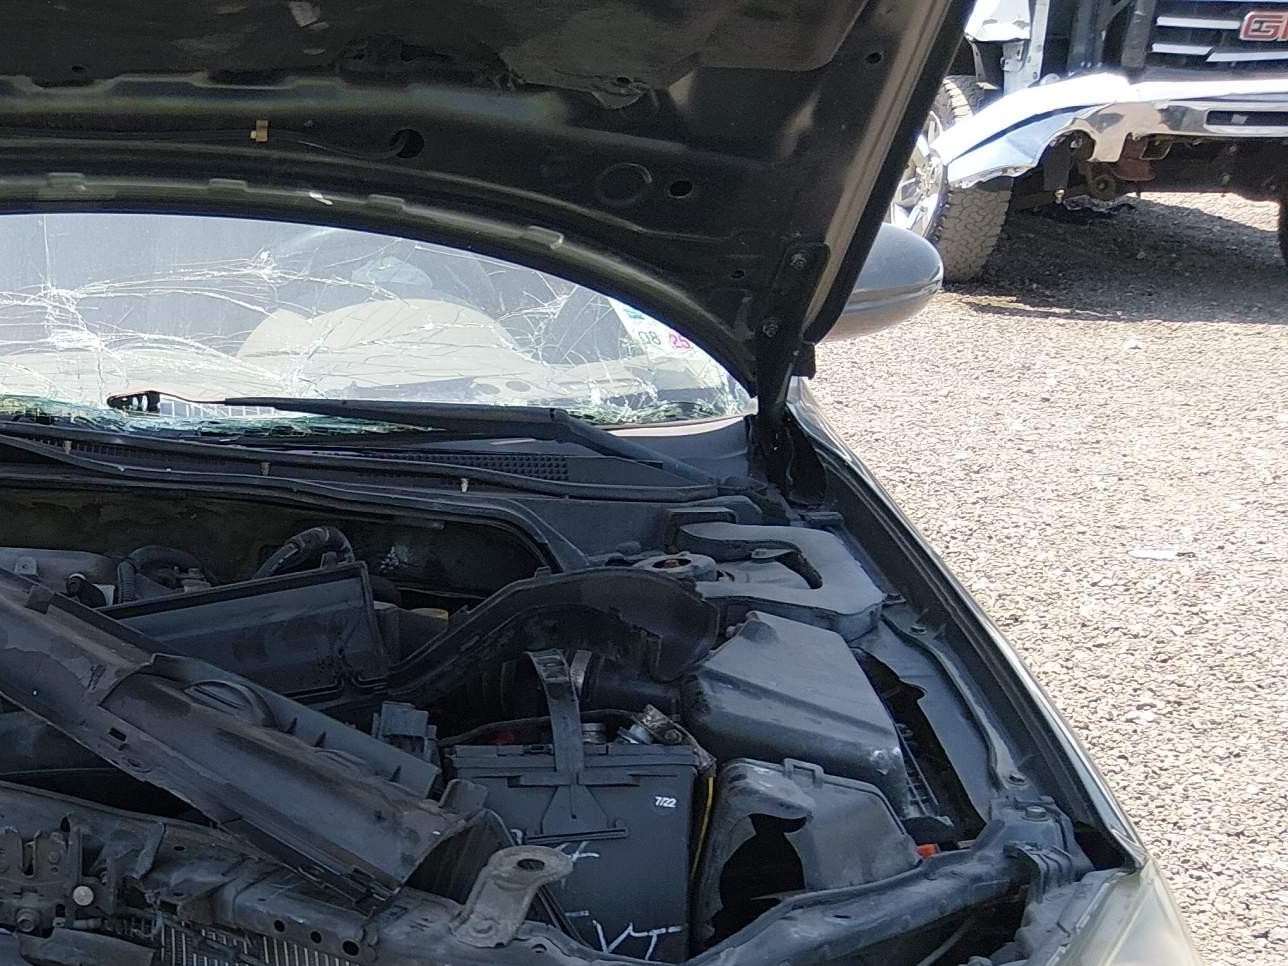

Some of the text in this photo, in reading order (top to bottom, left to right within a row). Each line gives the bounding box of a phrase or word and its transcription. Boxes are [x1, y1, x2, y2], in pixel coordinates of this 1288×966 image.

[1240, 11, 1288, 41] G
[668, 332, 692, 350] 25
[655, 796, 677, 808] 7/22
